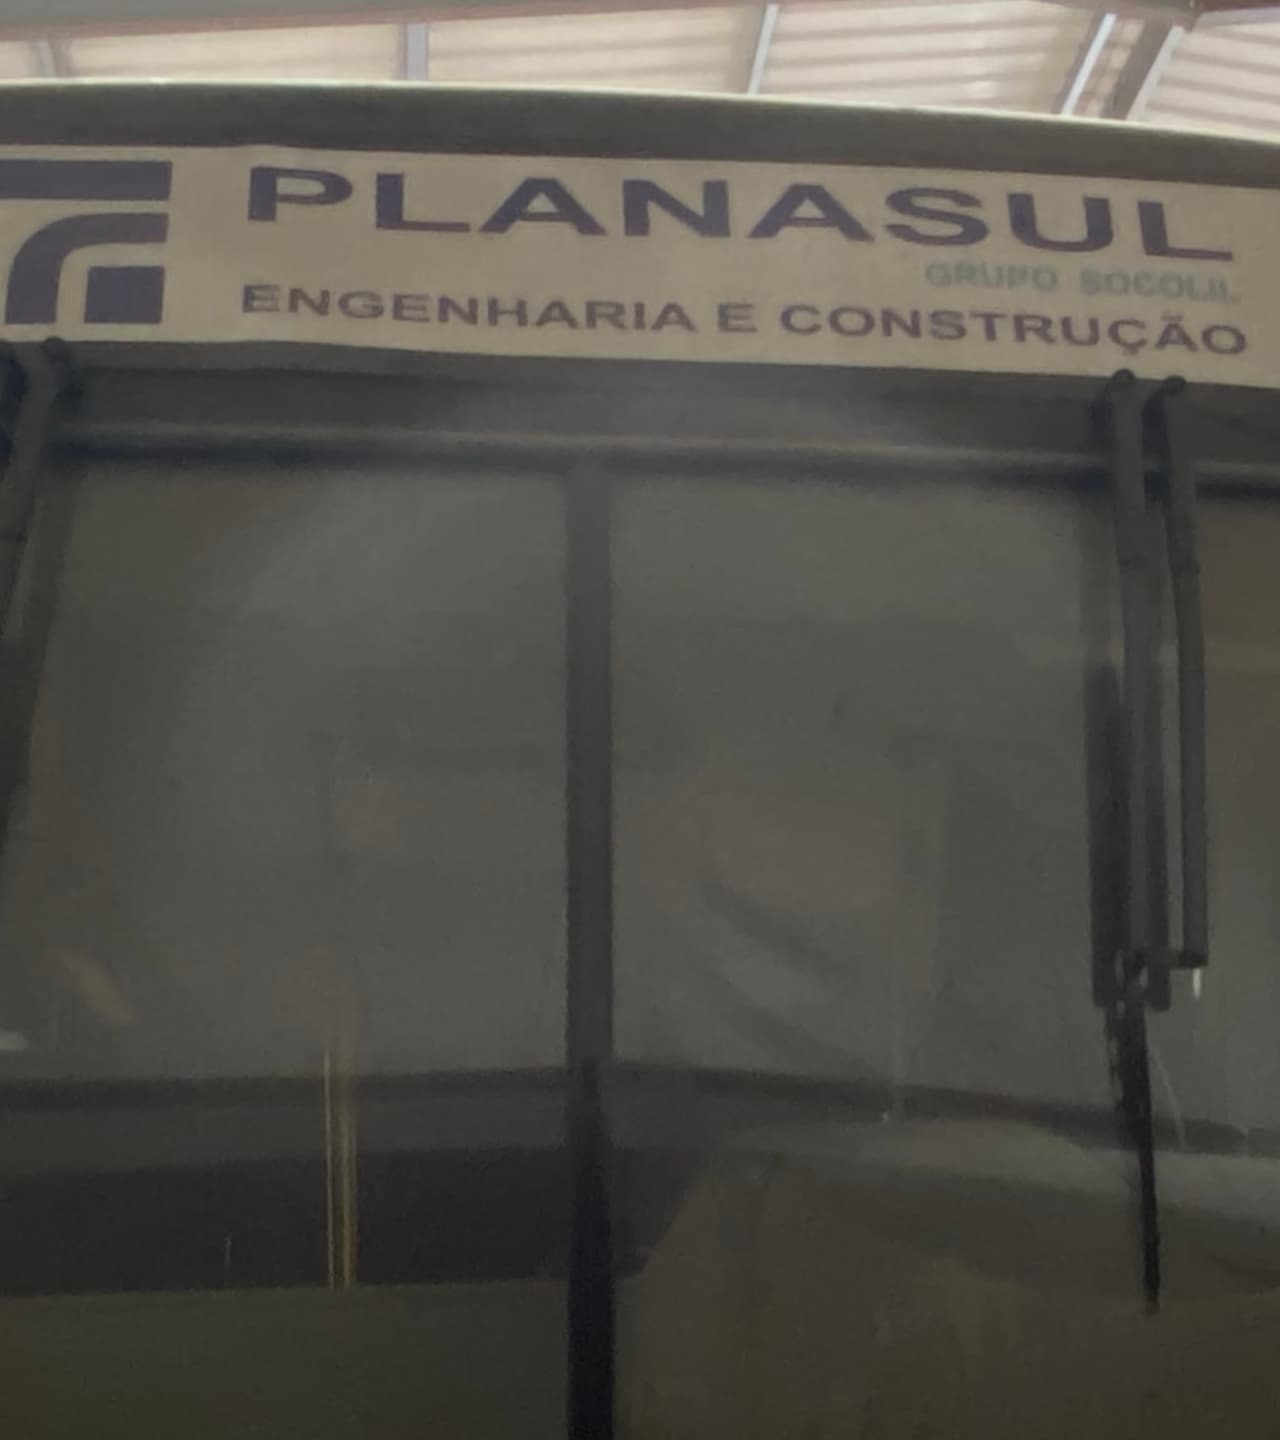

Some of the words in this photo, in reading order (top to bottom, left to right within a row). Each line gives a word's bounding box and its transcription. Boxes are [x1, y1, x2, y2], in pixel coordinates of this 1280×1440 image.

[247, 165, 1234, 262] PLANASUL
[925, 259, 1058, 293] GRUPO
[241, 284, 697, 333] ENGENHARIA
[718, 303, 757, 333] E
[780, 304, 1247, 356] CONSTRUÇÃO
